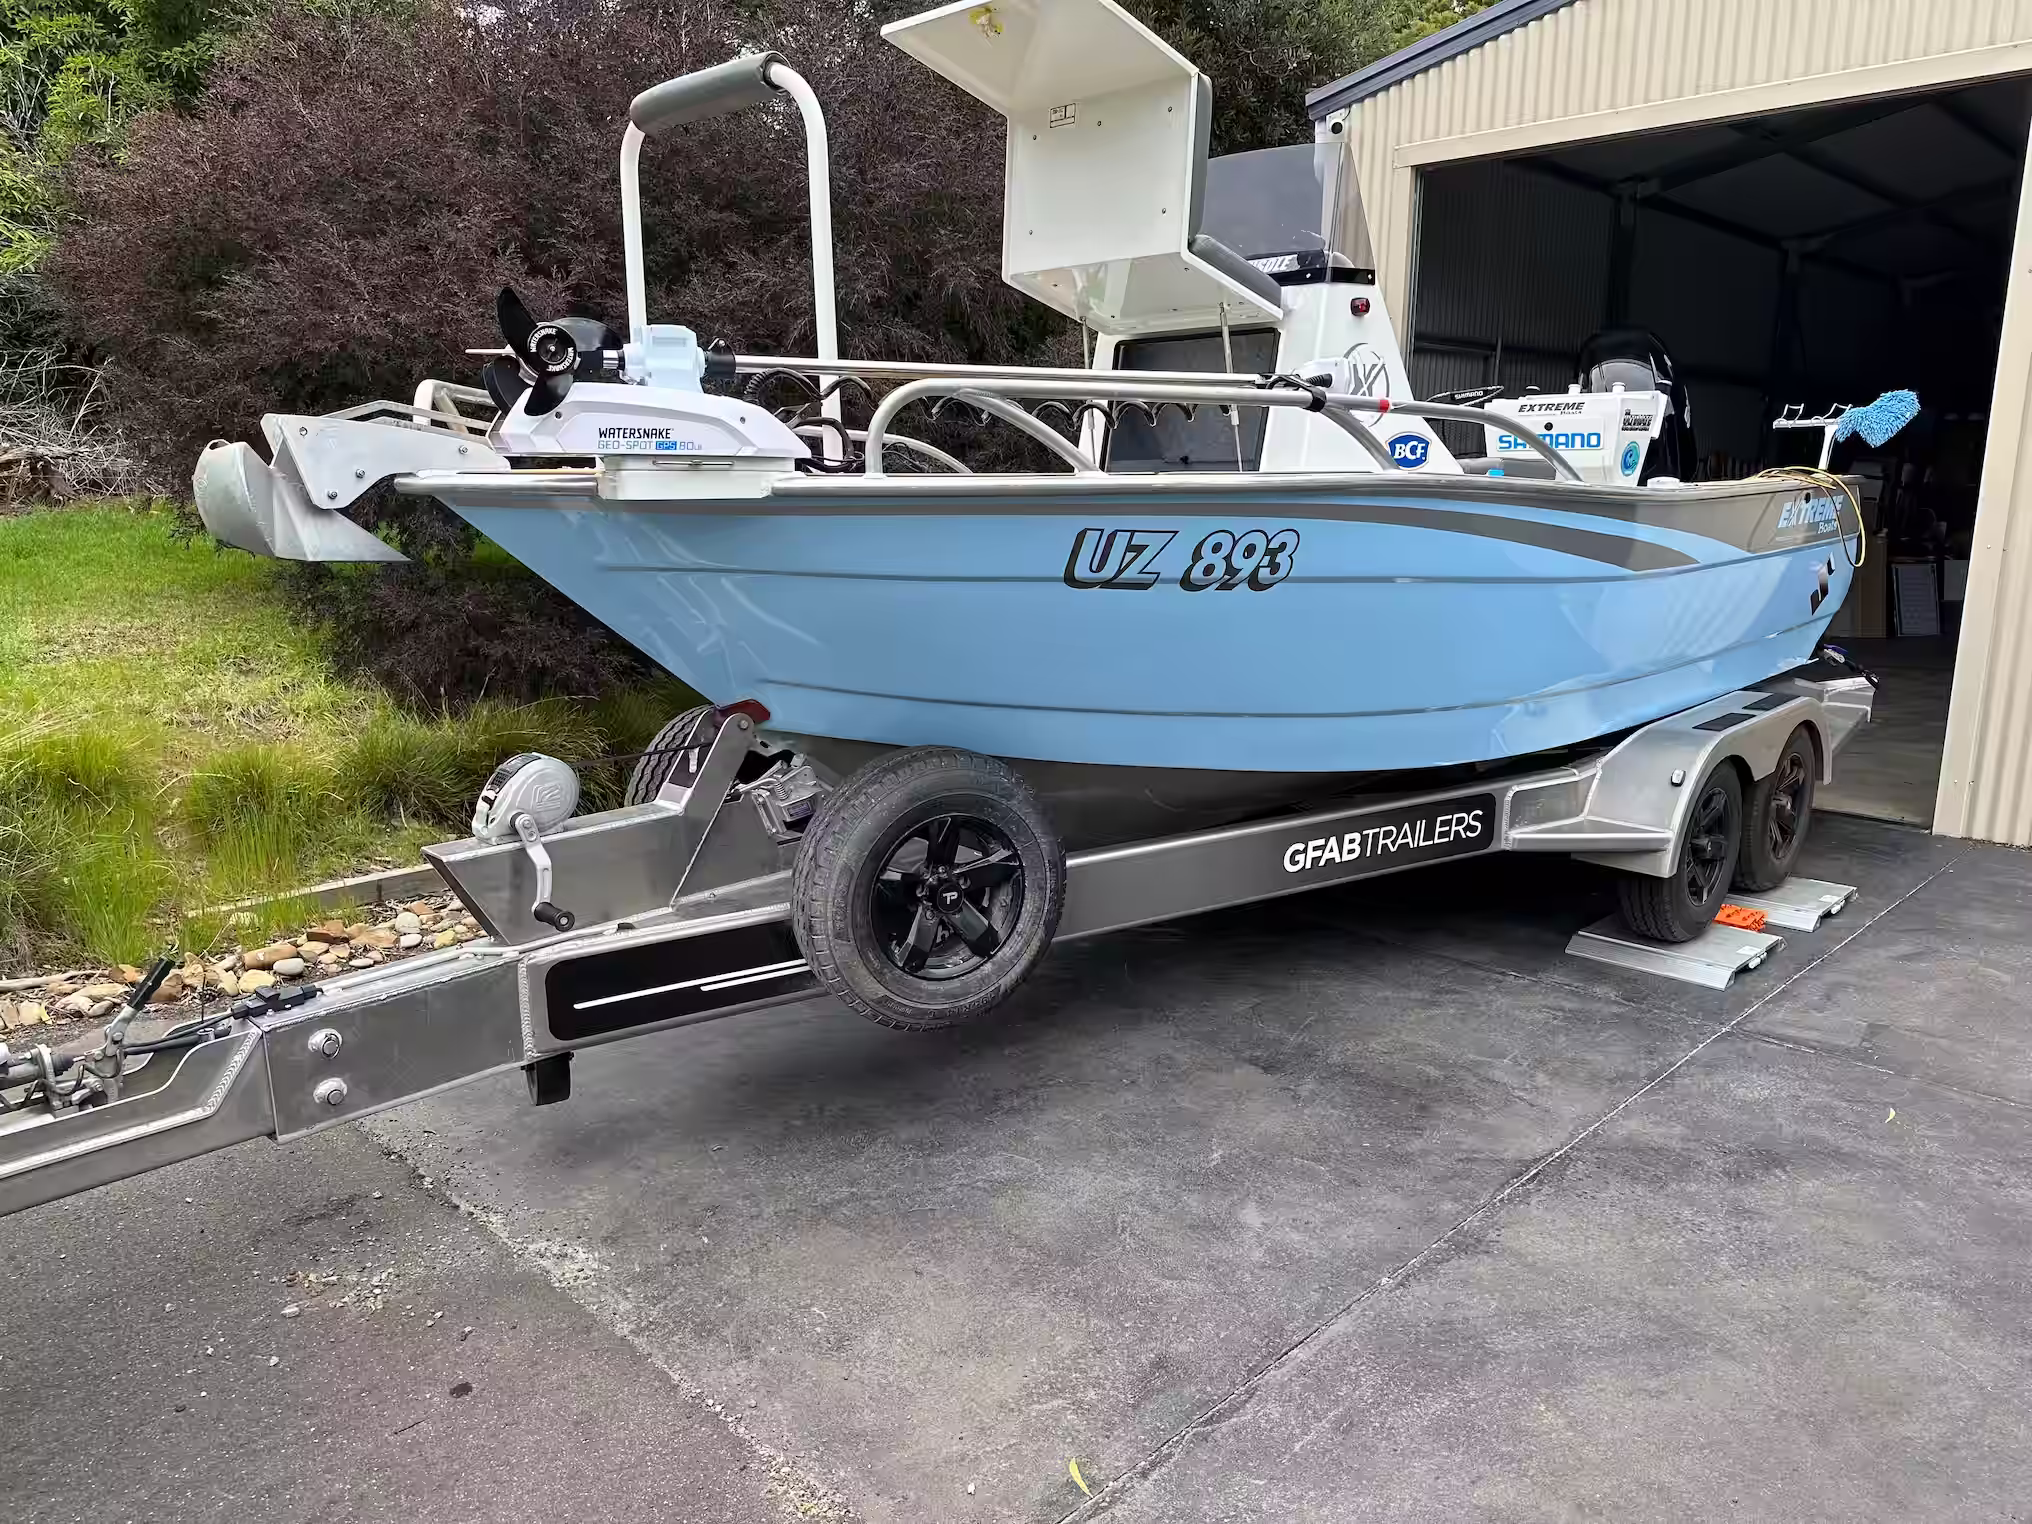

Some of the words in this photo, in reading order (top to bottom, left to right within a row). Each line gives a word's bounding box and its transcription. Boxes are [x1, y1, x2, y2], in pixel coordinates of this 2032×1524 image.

[530, 327, 558, 353] WATERSNAKE
[1454, 390, 1484, 400] SHIMANO
[1518, 402, 1586, 413] EXTREME
[598, 427, 672, 439] WATERSNAKE
[1498, 432, 1601, 449] SHMANO
[597, 440, 653, 450] GEO-SPOT
[656, 441, 677, 450] GPS
[1393, 440, 1426, 460] BCF
[1777, 495, 1845, 529] EXTREME
[1818, 520, 1838, 533] Boats
[1063, 527, 1180, 591] UZ
[1179, 528, 1301, 592] 893
